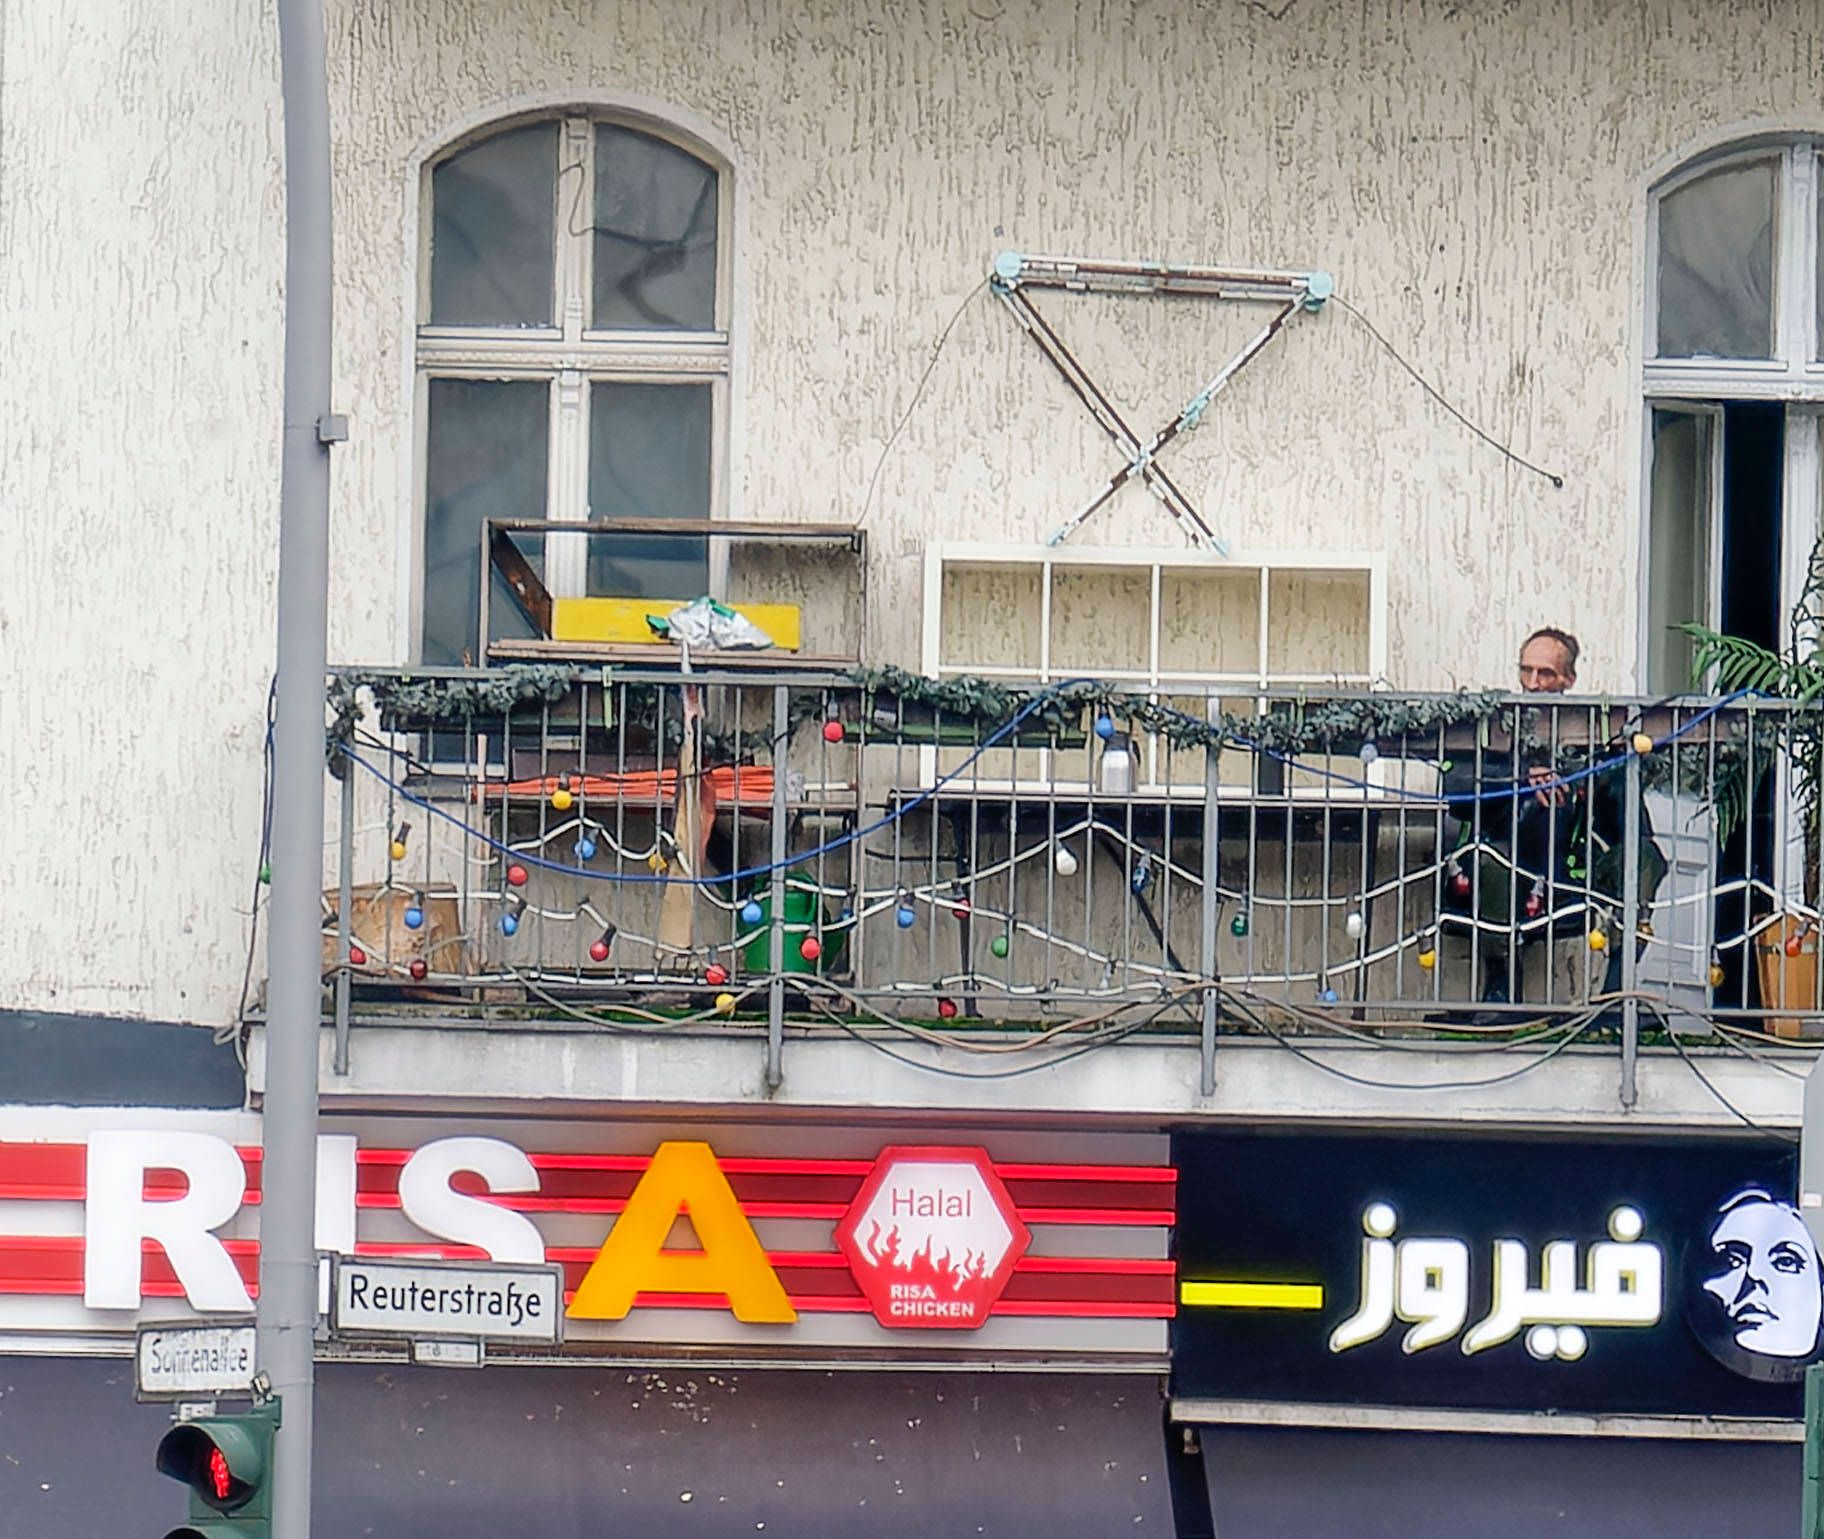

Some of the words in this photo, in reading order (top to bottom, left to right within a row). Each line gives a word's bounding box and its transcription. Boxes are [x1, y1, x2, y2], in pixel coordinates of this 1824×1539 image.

[891, 1187, 972, 1218] Halal
[86, 1129, 799, 1325] RISA
[349, 1273, 542, 1327] Reuterstraße
[890, 1284, 937, 1299] RISA
[1329, 1202, 1664, 1362] فيروز
[890, 1301, 975, 1318] CHICKEN
